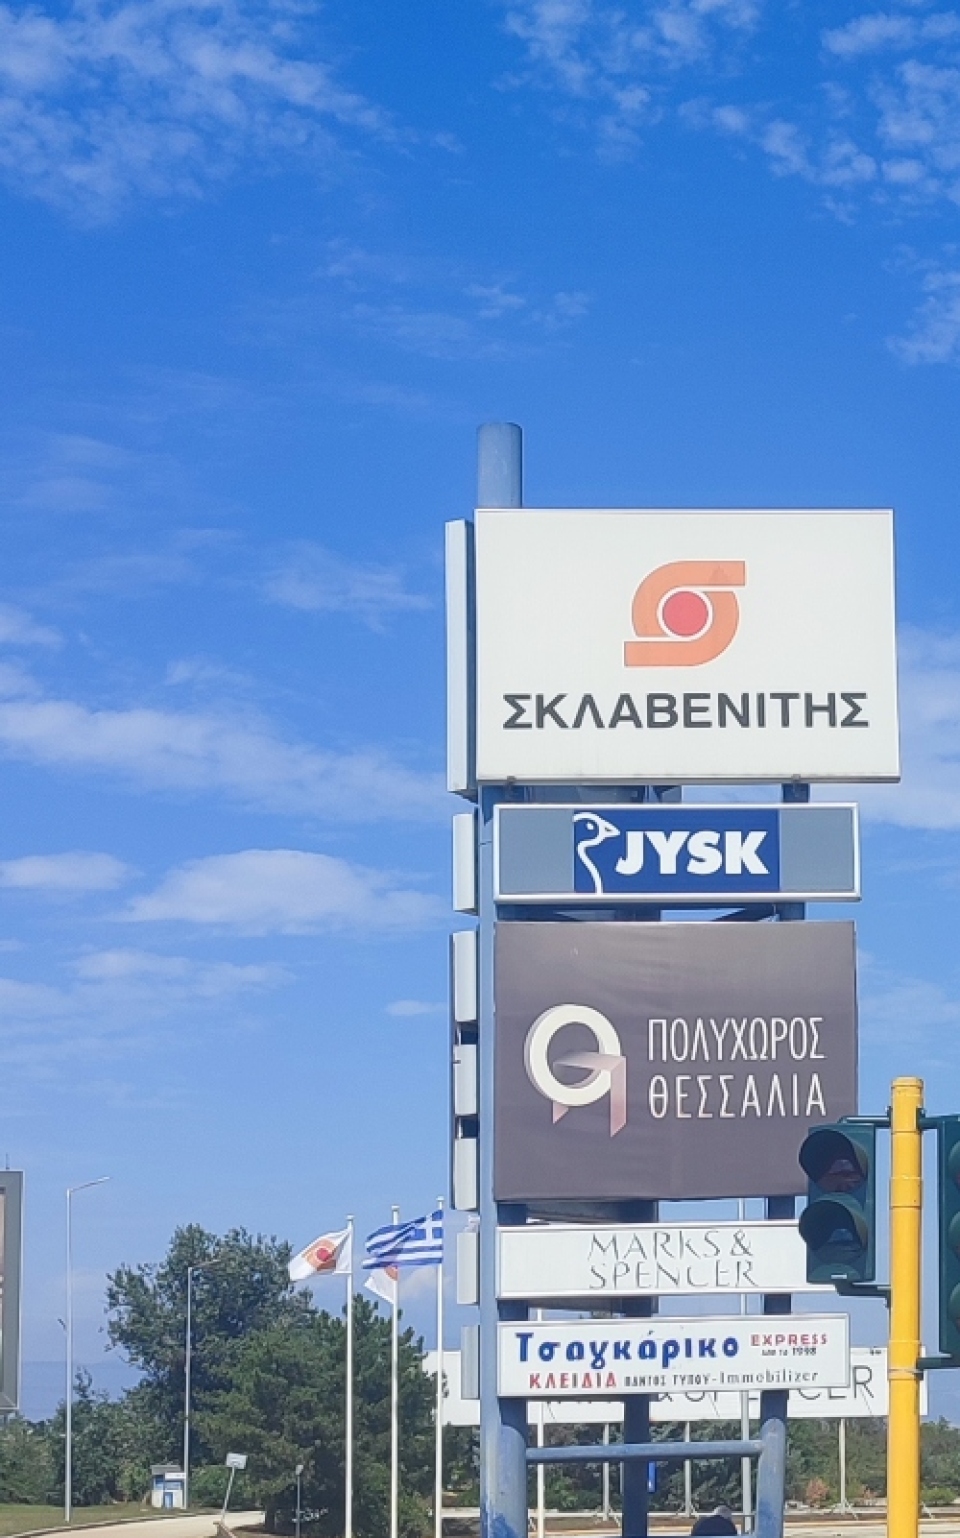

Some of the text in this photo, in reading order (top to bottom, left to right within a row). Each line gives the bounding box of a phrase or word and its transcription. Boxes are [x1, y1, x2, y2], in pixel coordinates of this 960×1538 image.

[502, 692, 870, 729] ΣΚΛΑΒΕΝΙΤΗΣ
[614, 830, 769, 875] JYSK
[648, 1016, 827, 1062] ΠΟΛΥΧΩΡΟΣ
[648, 1073, 827, 1119] ΘΕΣΣΑΛΙΑ
[587, 1229, 753, 1260] MARKS &
[589, 1260, 758, 1289] SPENCER
[515, 1330, 739, 1370] Τσαγκάρικο
[750, 1333, 828, 1347] EXPRESS
[529, 1372, 617, 1389] ΚΛΕΙΔΙΑ
